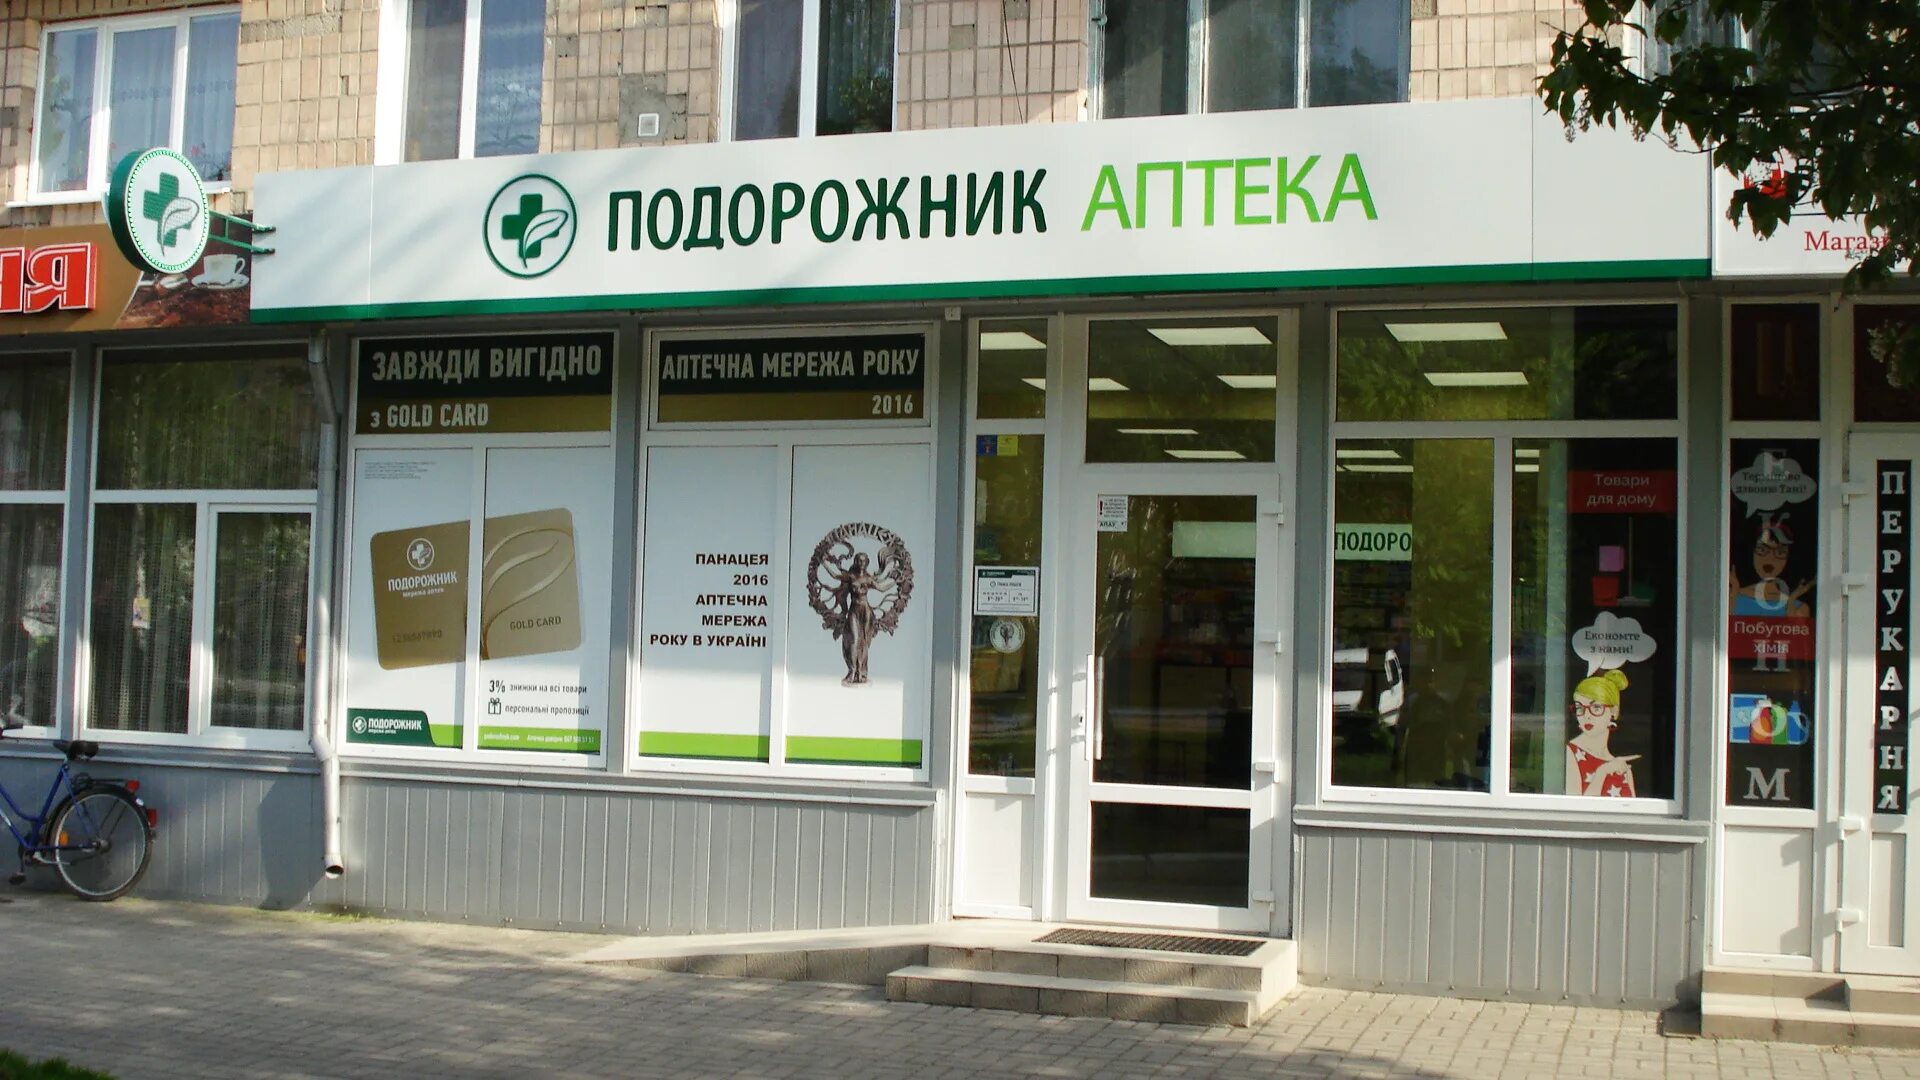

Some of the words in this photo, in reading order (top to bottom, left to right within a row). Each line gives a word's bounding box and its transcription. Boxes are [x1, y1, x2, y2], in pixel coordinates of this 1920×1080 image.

[608, 168, 1047, 251] ПОДОРОЖНИК
[1081, 153, 1378, 232] АПТЕКА
[372, 349, 480, 385] ЗАВЖДИ
[489, 345, 602, 383] ВИГІДНО
[662, 353, 755, 381] АПТЕЧНА
[762, 350, 856, 379] МЕРЕЖА
[862, 348, 919, 377] РОКУ
[871, 394, 914, 416] 2016
[386, 403, 433, 428] GOLD
[439, 402, 490, 427] CARD
[1593, 473, 1650, 489] Товари
[1586, 494, 1614, 507] для
[1616, 494, 1657, 508] дому
[1335, 531, 1412, 552] ПОДОРО
[695, 553, 769, 567] ПАНАЦЕЯ
[388, 571, 458, 593] ПОДОРОЖНИК
[733, 574, 769, 586] 2016
[695, 594, 768, 606] АПТЕЧНА
[510, 618, 534, 631] GOLD
[536, 615, 562, 628] CARD
[701, 614, 767, 627] МЕРЕЖА
[1585, 631, 1640, 641] Економте
[1734, 621, 1809, 638] Побутова
[650, 634, 688, 646] РОКУ
[692, 634, 702, 646] В
[707, 633, 767, 647] УКРАЇНІ
[1878, 471, 1906, 810] ПЕРУКАРНЯ
[489, 680, 506, 693] 3%
[510, 684, 537, 692] знижки
[539, 684, 548, 692] на
[550, 684, 560, 692] всі
[562, 685, 587, 695] товари
[505, 704, 549, 715] персональні
[550, 705, 589, 716] пропозиції
[368, 717, 422, 731] ПОДОРОЖНИК
